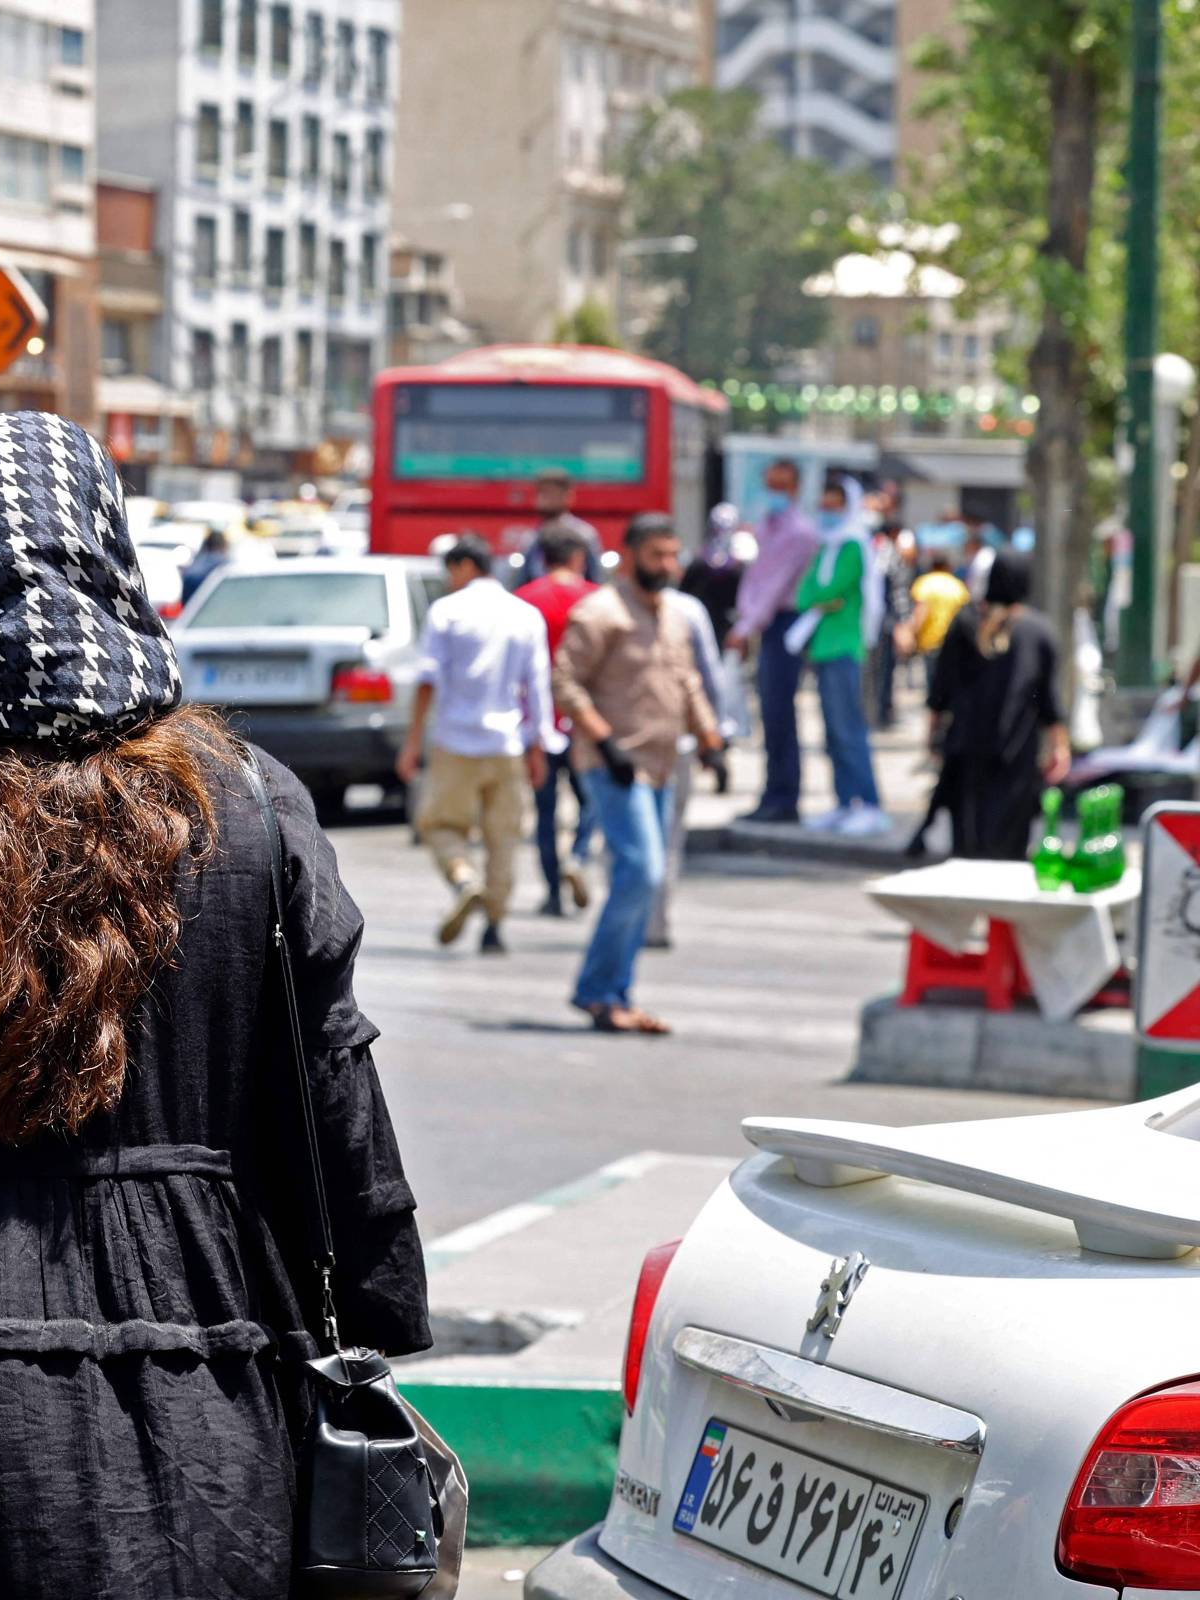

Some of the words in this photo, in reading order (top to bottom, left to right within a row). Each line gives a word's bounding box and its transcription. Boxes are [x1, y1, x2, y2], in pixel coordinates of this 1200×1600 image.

[677, 1508, 697, 1526] IRAN
[875, 1491, 916, 1522] ایران
[849, 1518, 895, 1595] ۴۰
